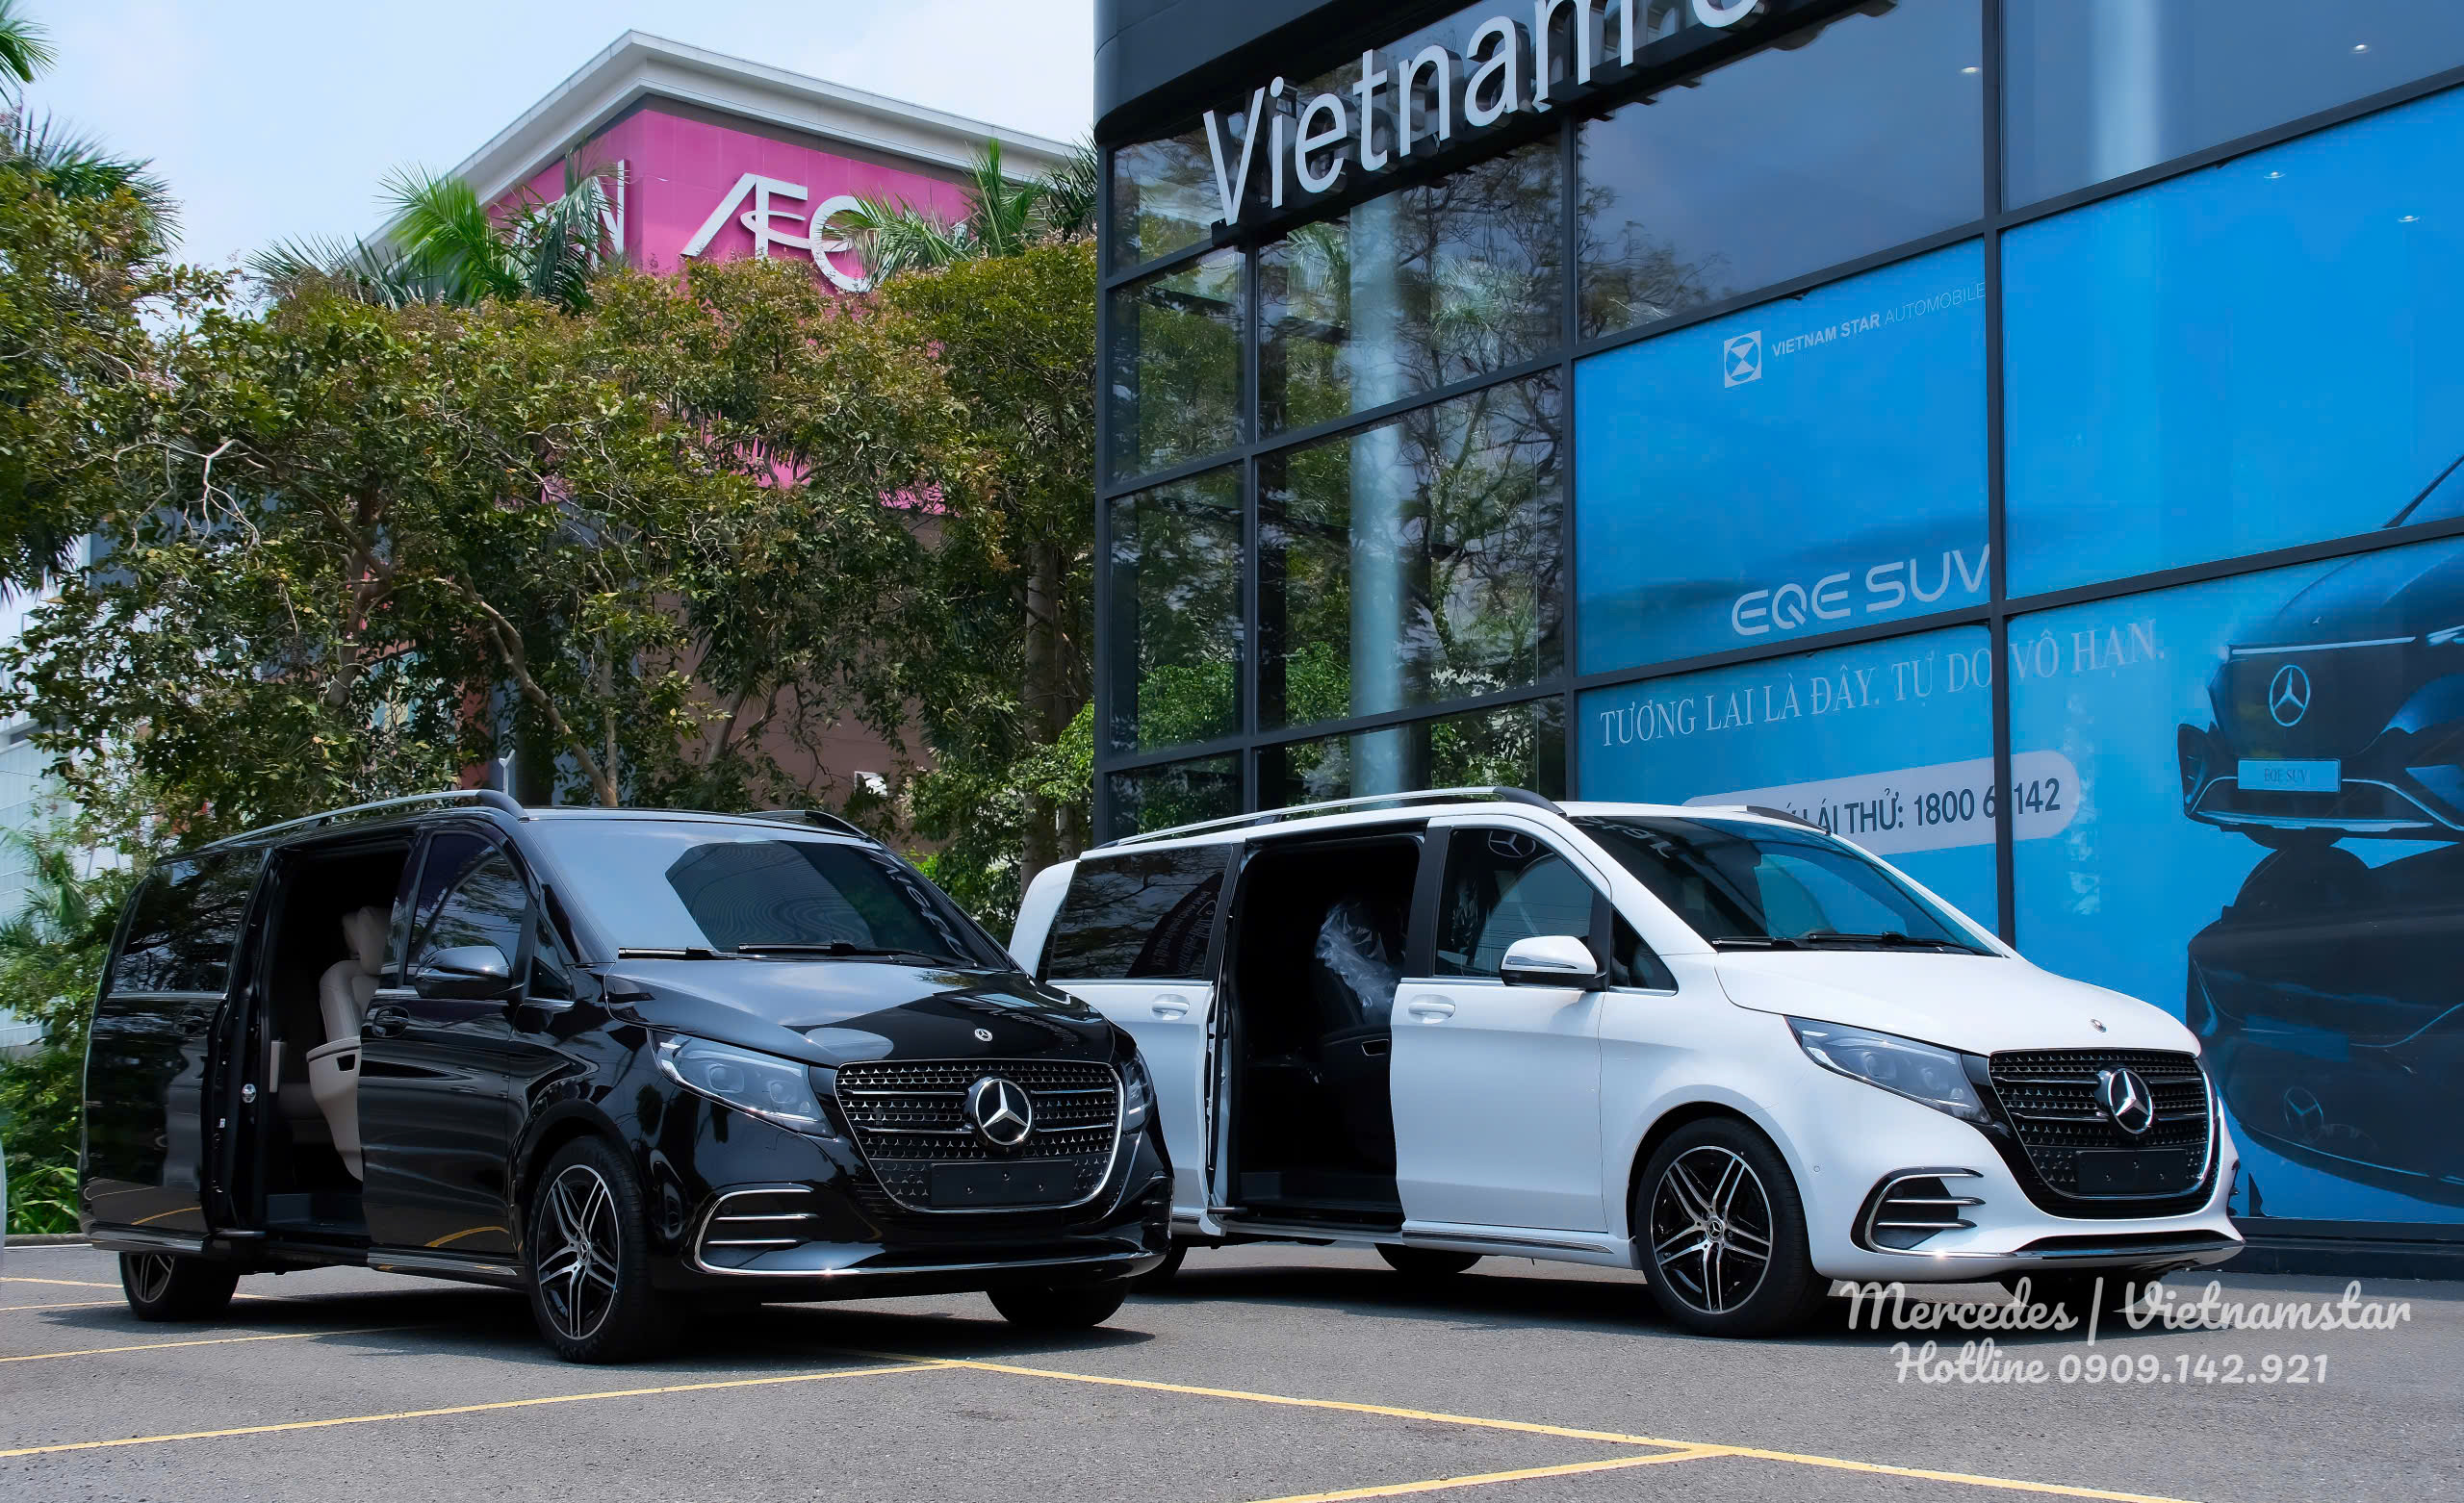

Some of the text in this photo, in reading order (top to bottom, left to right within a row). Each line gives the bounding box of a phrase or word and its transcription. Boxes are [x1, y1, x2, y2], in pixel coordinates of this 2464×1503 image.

[1203, 0, 1633, 226] Vietnam
[1772, 327, 1836, 358] VIETNAM
[1840, 313, 1880, 338] STAR
[1732, 544, 1989, 635] EQE SUV
[1600, 699, 1696, 747] TƯƠNG
[1706, 688, 1754, 731] LAI
[1763, 673, 1802, 723] LÀ
[1947, 648, 1993, 693] DO
[2009, 628, 2059, 682] VÔ
[1843, 788, 1904, 834] THỬ:
[1914, 788, 1975, 827] 1800
